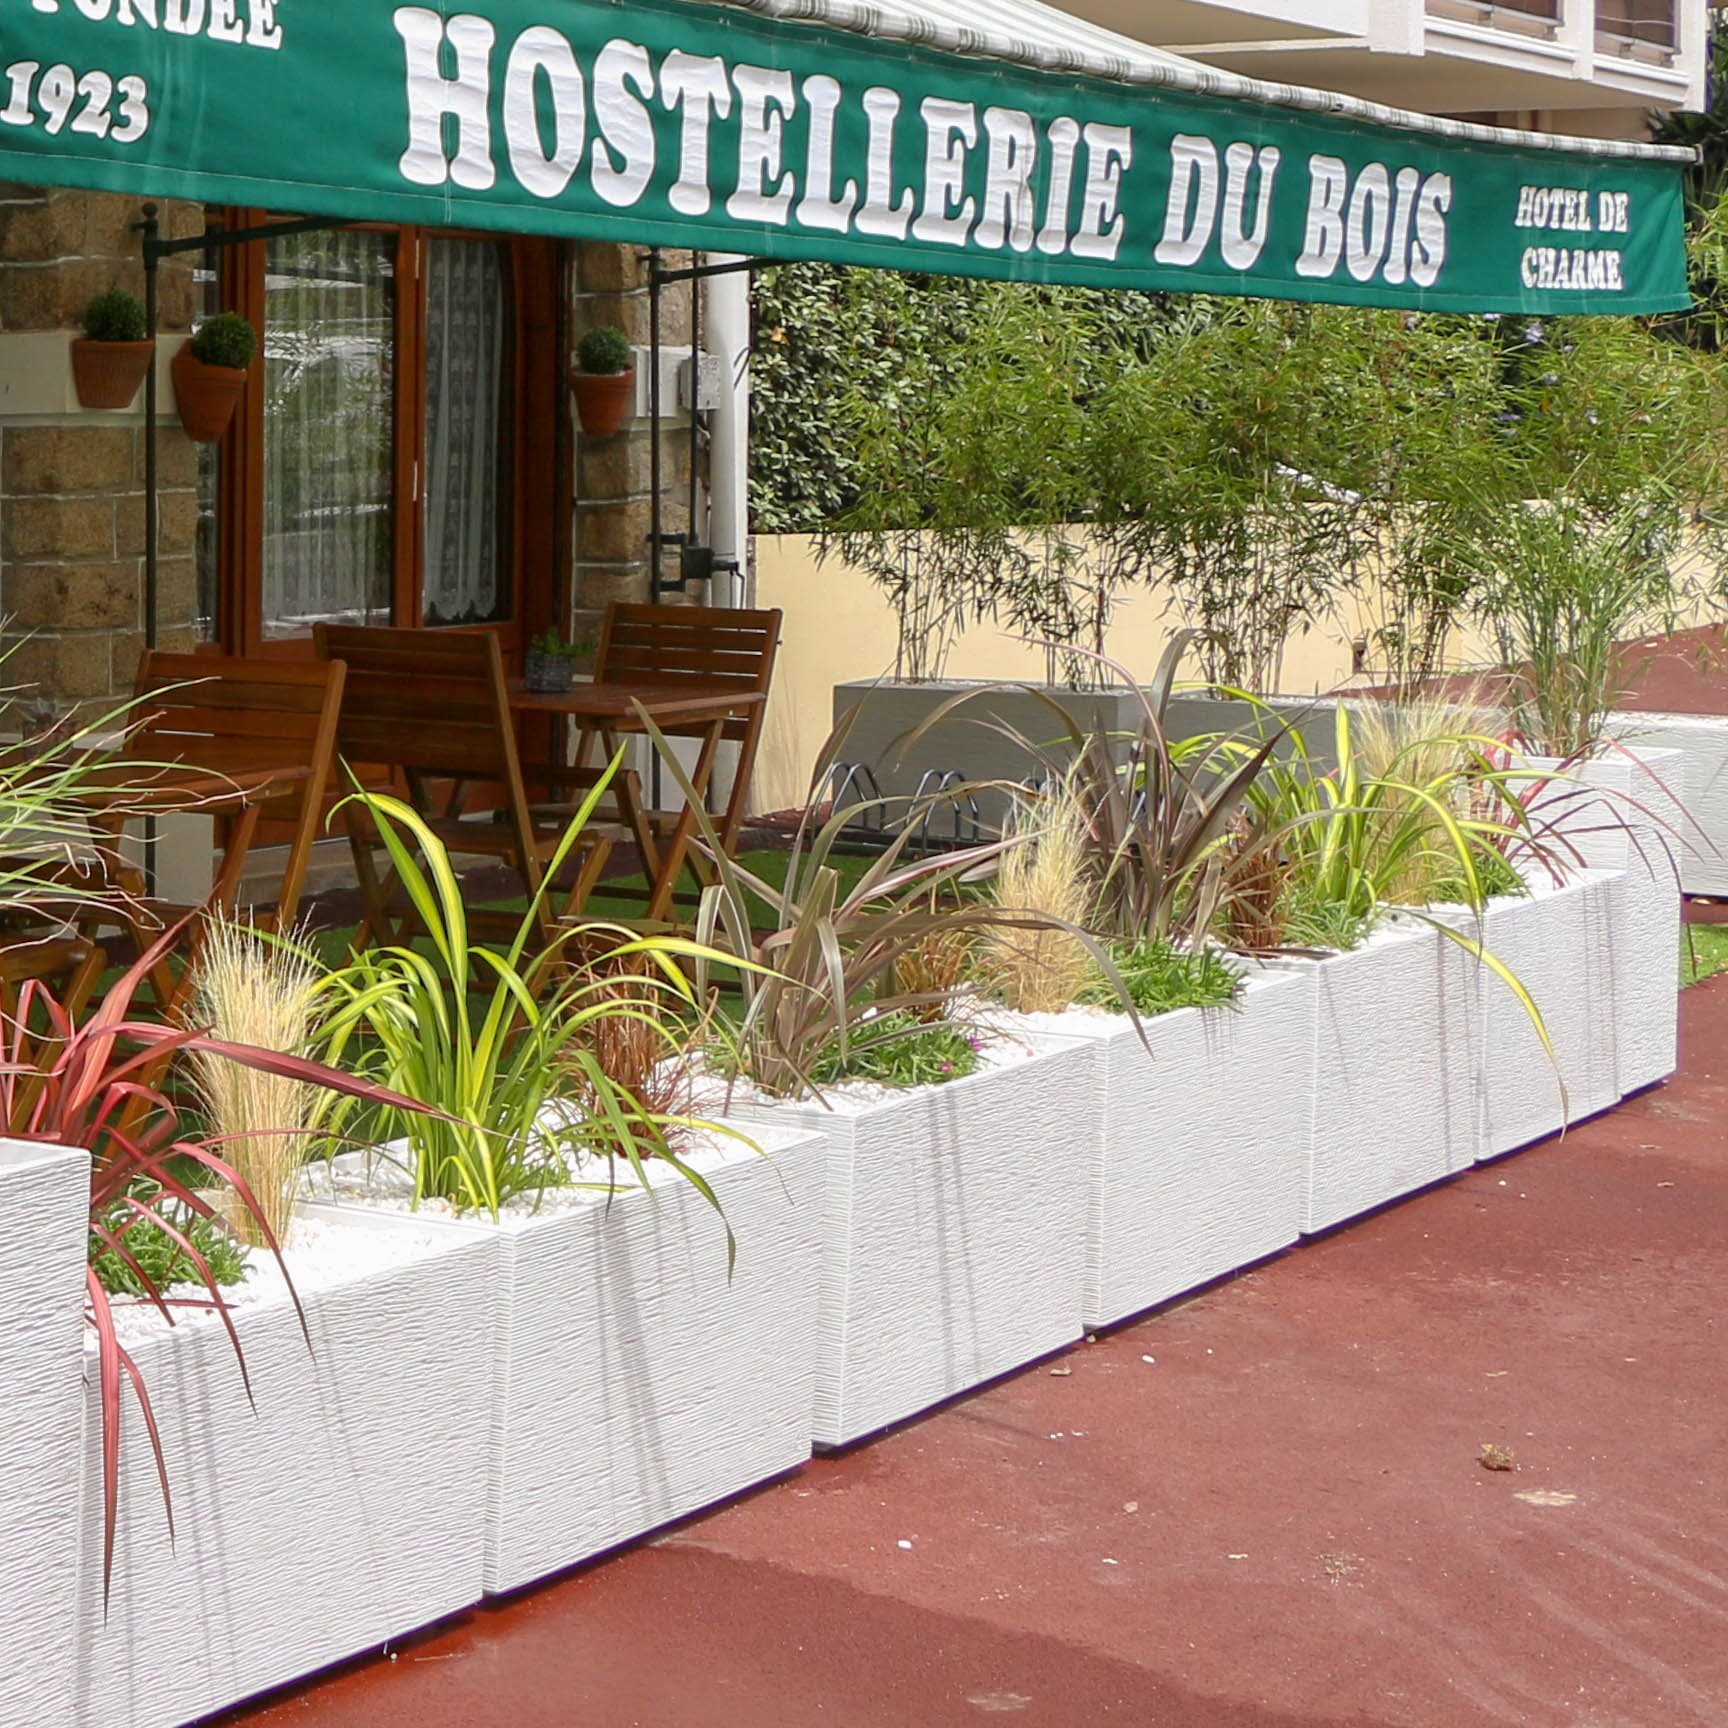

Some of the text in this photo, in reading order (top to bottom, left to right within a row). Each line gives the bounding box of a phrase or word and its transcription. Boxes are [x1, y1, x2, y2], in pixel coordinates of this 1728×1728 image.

[391, 5, 1453, 289] HOSTELLERIE DU BOIS
[1514, 185, 1630, 233] HOTEL DE
[1520, 246, 1625, 291] CHARME
